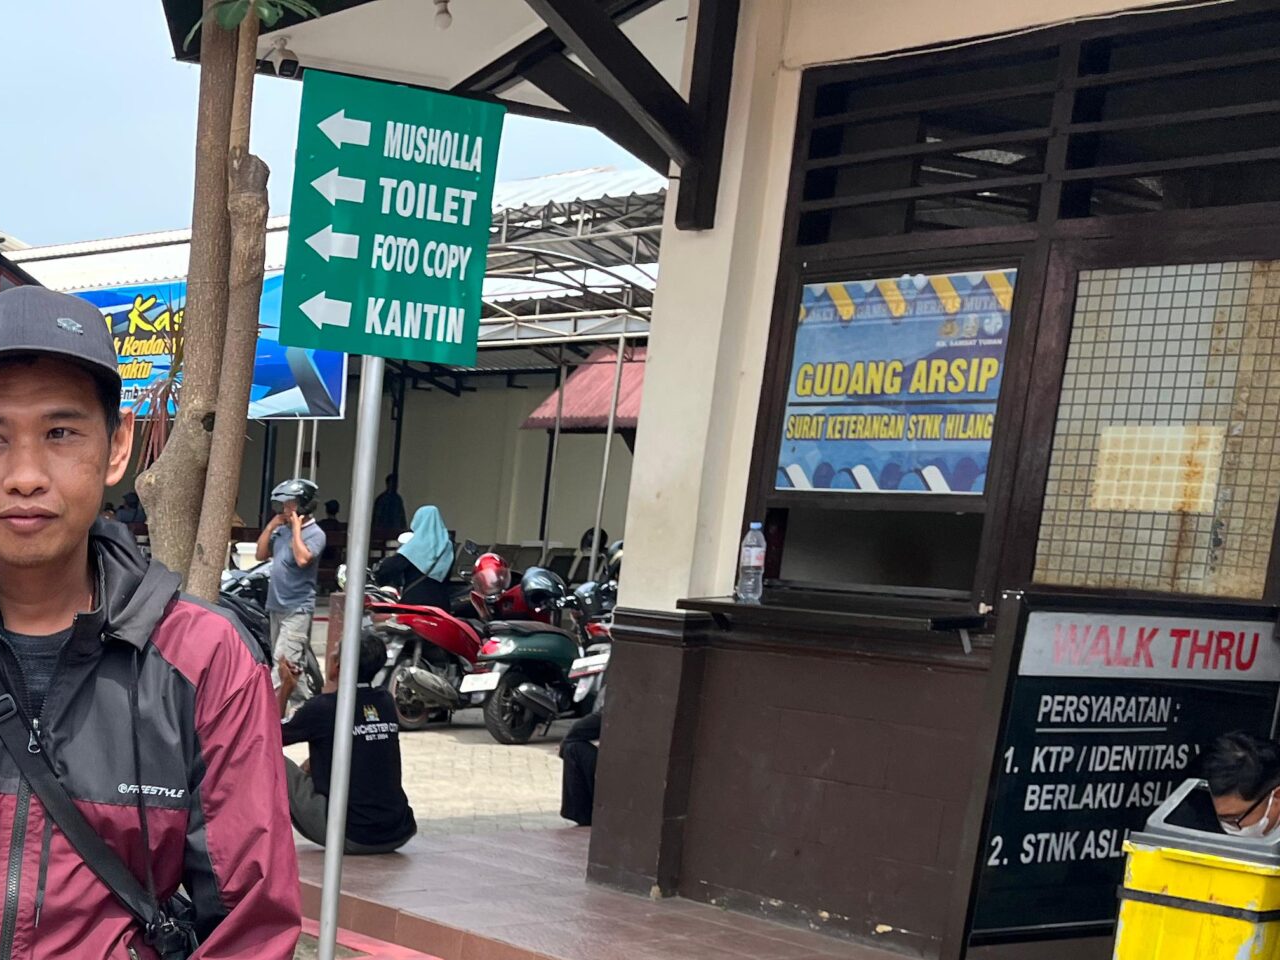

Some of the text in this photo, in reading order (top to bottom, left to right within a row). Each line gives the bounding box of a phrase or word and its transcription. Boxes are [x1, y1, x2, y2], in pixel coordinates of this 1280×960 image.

[383, 120, 483, 173] MUSHOLLA
[378, 177, 477, 226] TOILET
[371, 234, 473, 281] FOTO COPY
[128, 295, 185, 334] Kas
[364, 296, 465, 344] KANTIN
[795, 357, 1000, 396] GUDANG ARSIP
[786, 413, 994, 440] SURAT KETERANGAN STNK HILANG
[1051, 623, 1260, 672] WALK THRU
[1036, 695, 1172, 724] PERSYARATAN
[1004, 746, 1020, 774] 1.
[1031, 746, 1074, 773] KTP
[1088, 745, 1188, 772] IDENTITAS
[1024, 784, 1124, 811] BERLAKU
[987, 836, 1009, 867] 2.
[1020, 832, 1080, 864] STNK
